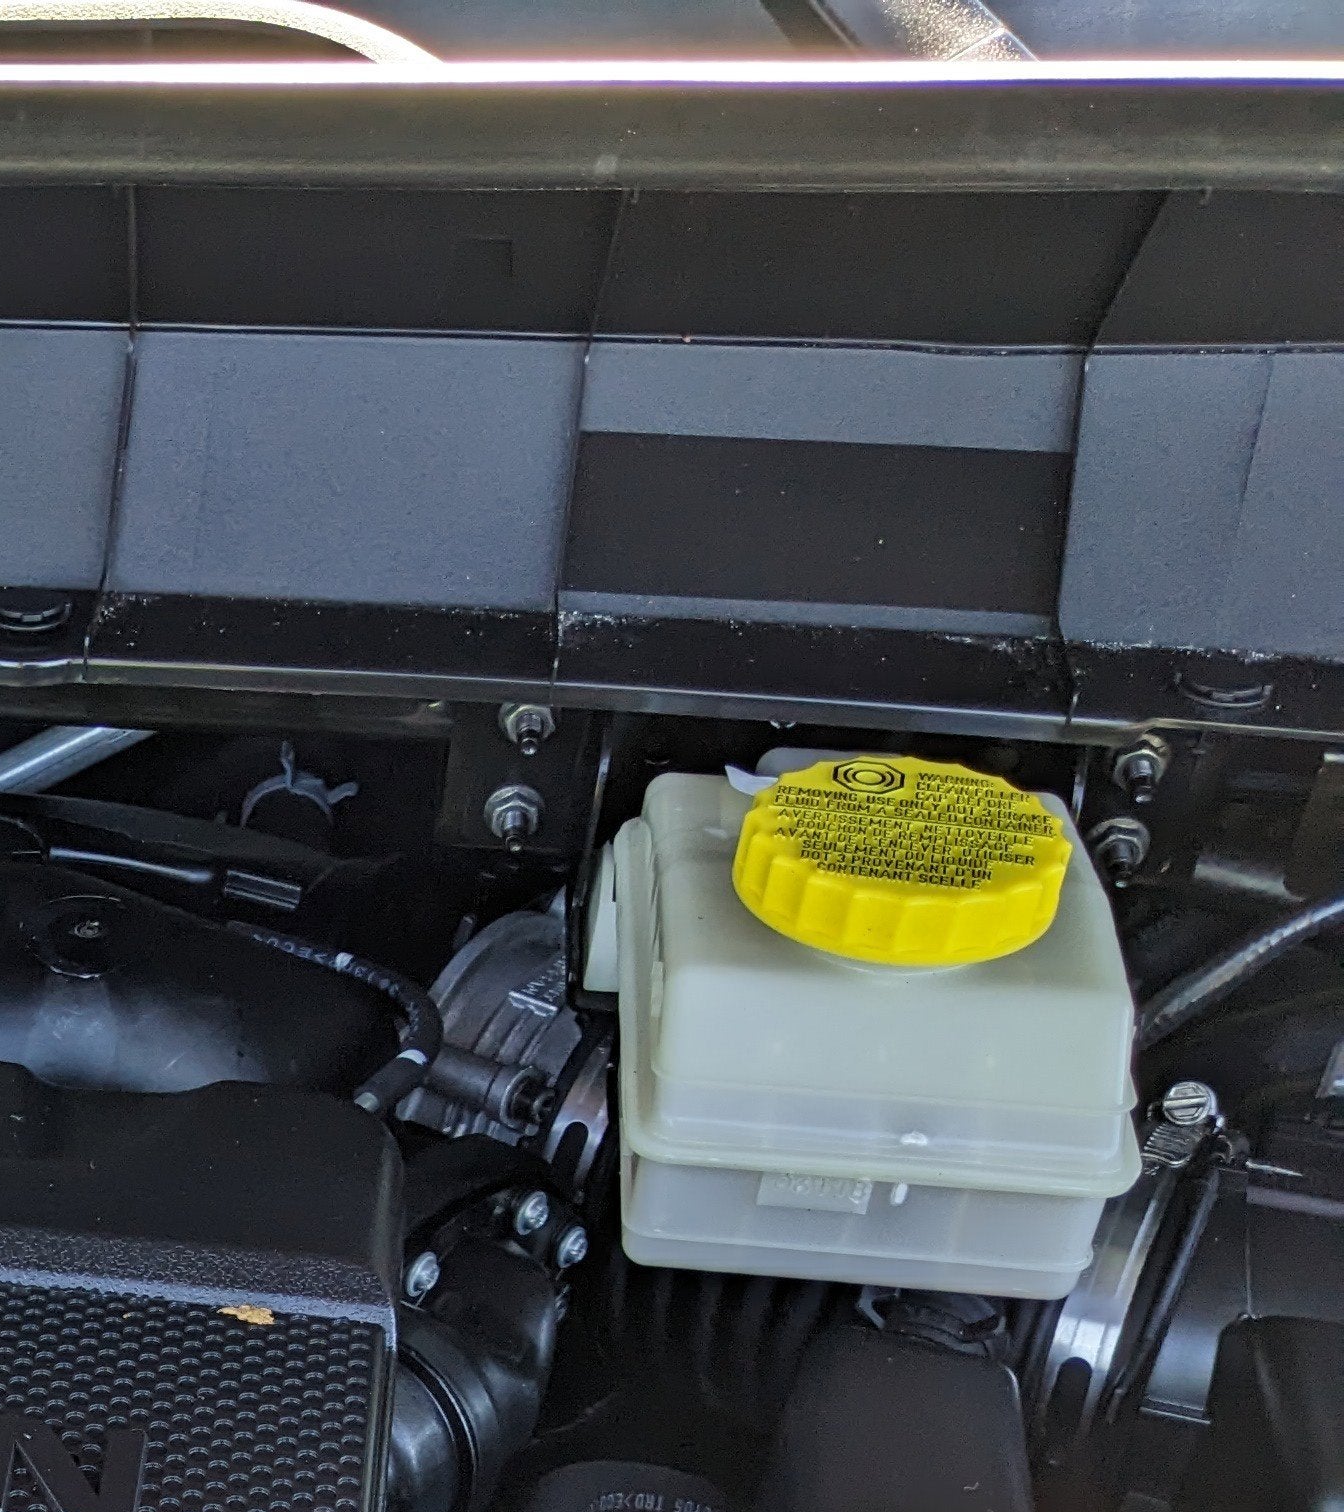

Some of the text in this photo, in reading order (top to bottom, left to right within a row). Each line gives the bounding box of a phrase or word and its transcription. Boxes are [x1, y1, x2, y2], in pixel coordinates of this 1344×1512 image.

[914, 791, 946, 803] CAP
[774, 794, 820, 807] FLUID
[825, 800, 871, 814] FROM
[875, 807, 888, 816] A
[894, 808, 958, 823] SEALED
[866, 795, 896, 807] USE
[899, 799, 940, 813] ONLY
[947, 804, 974, 816] DOT
[981, 808, 992, 817] 3
[997, 809, 1052, 823] BRAKE
[872, 826, 892, 838] DE
[923, 824, 1007, 843] NETTOYER
[776, 827, 829, 841] AVANT
[962, 848, 1036, 866] UTILISER
[802, 839, 897, 859] SEULEMENT
[800, 850, 829, 862] DOT
[836, 853, 846, 863] 3
[851, 855, 949, 875] PROVENANT
[816, 861, 912, 882] CONTENANT
